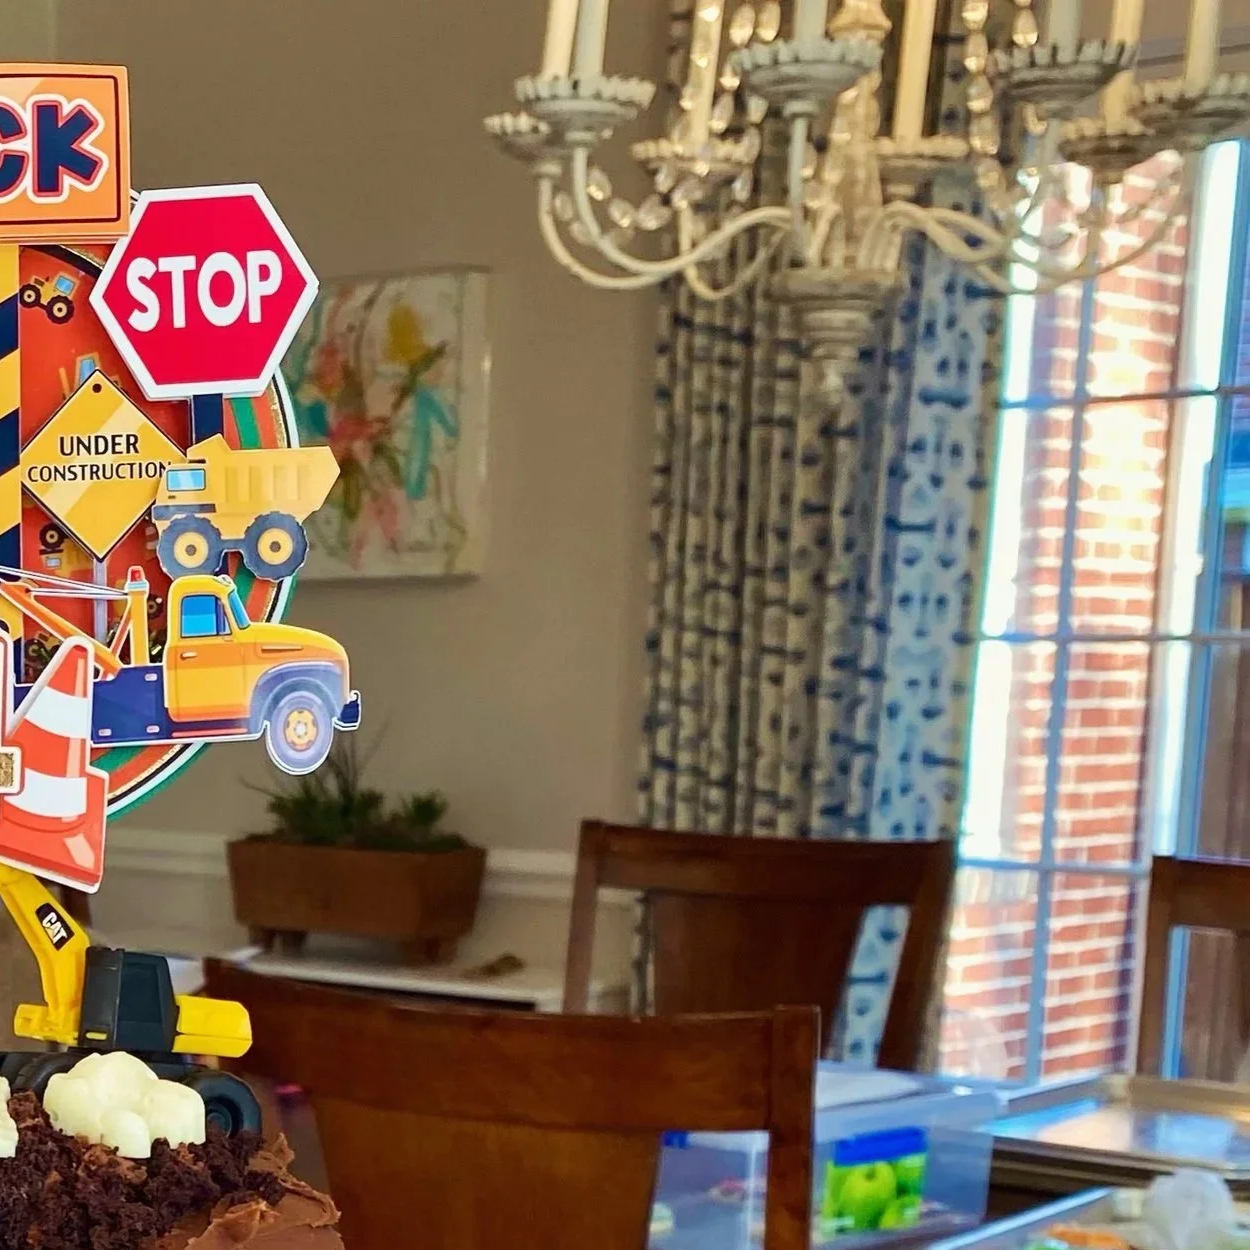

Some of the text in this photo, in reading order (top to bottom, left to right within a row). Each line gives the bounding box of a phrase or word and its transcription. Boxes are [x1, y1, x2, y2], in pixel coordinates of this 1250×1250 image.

[126, 250, 282, 332] STOP
[59, 434, 139, 456] UNDER
[42, 912, 68, 944] CAT
